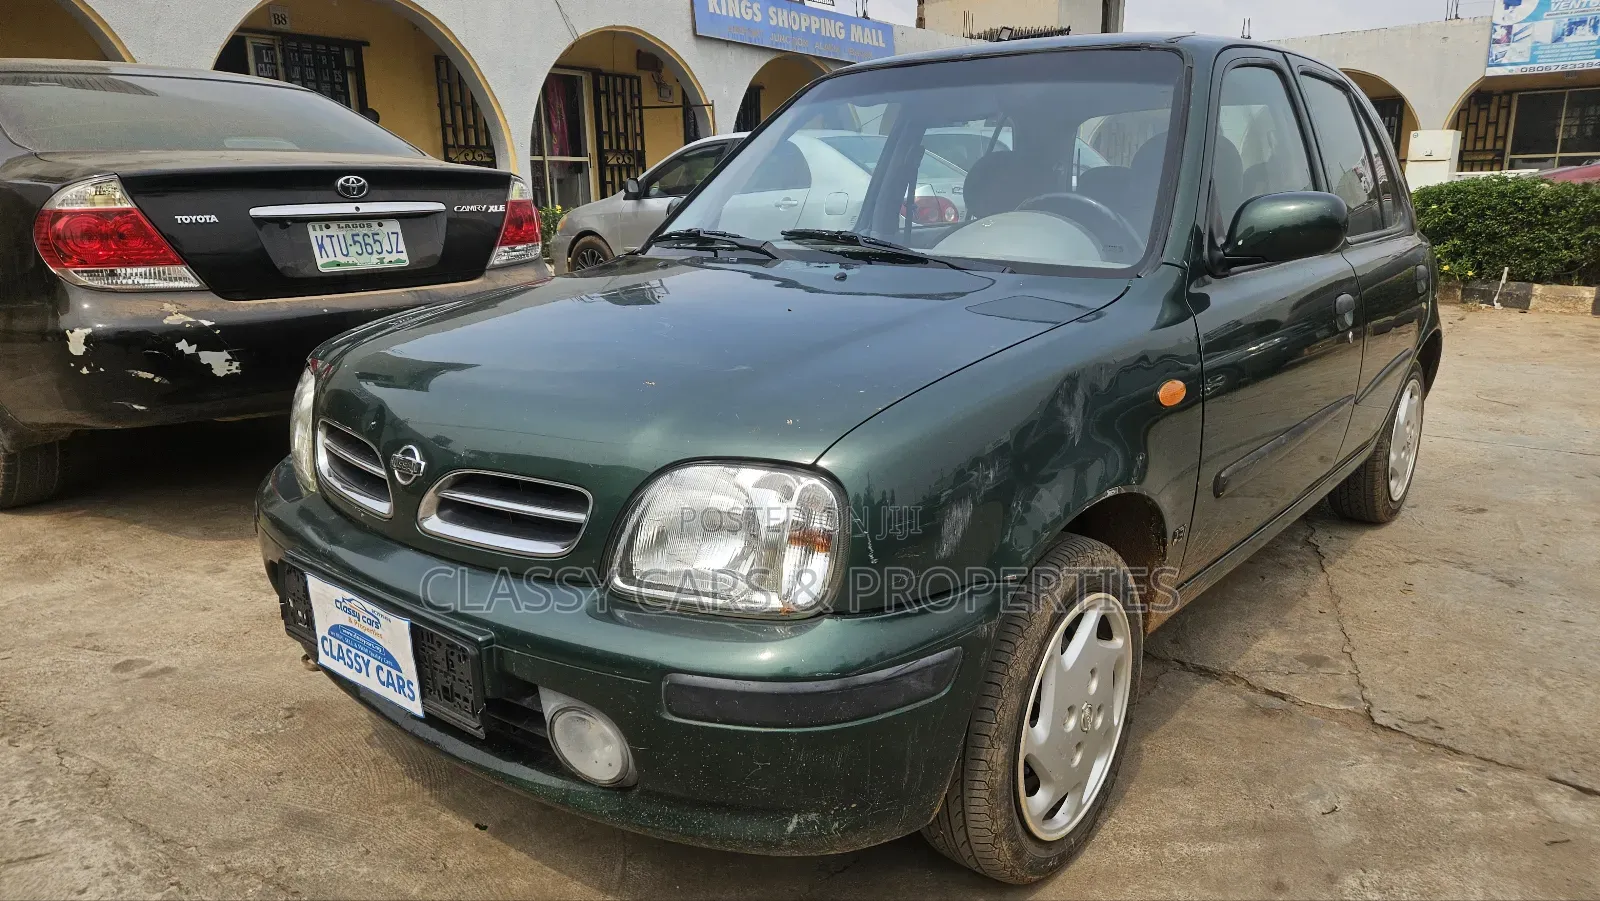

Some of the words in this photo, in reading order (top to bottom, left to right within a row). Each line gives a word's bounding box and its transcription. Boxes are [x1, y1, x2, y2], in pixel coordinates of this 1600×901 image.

[272, 13, 288, 25] B8
[708, 0, 762, 22] KINGS
[768, 6, 845, 39] SHOPPING
[850, 25, 886, 47] MALL
[487, 204, 506, 213] XLE
[174, 214, 219, 224] TOYOTA
[320, 635, 371, 678] CLASSY
[375, 664, 416, 702] CARS
